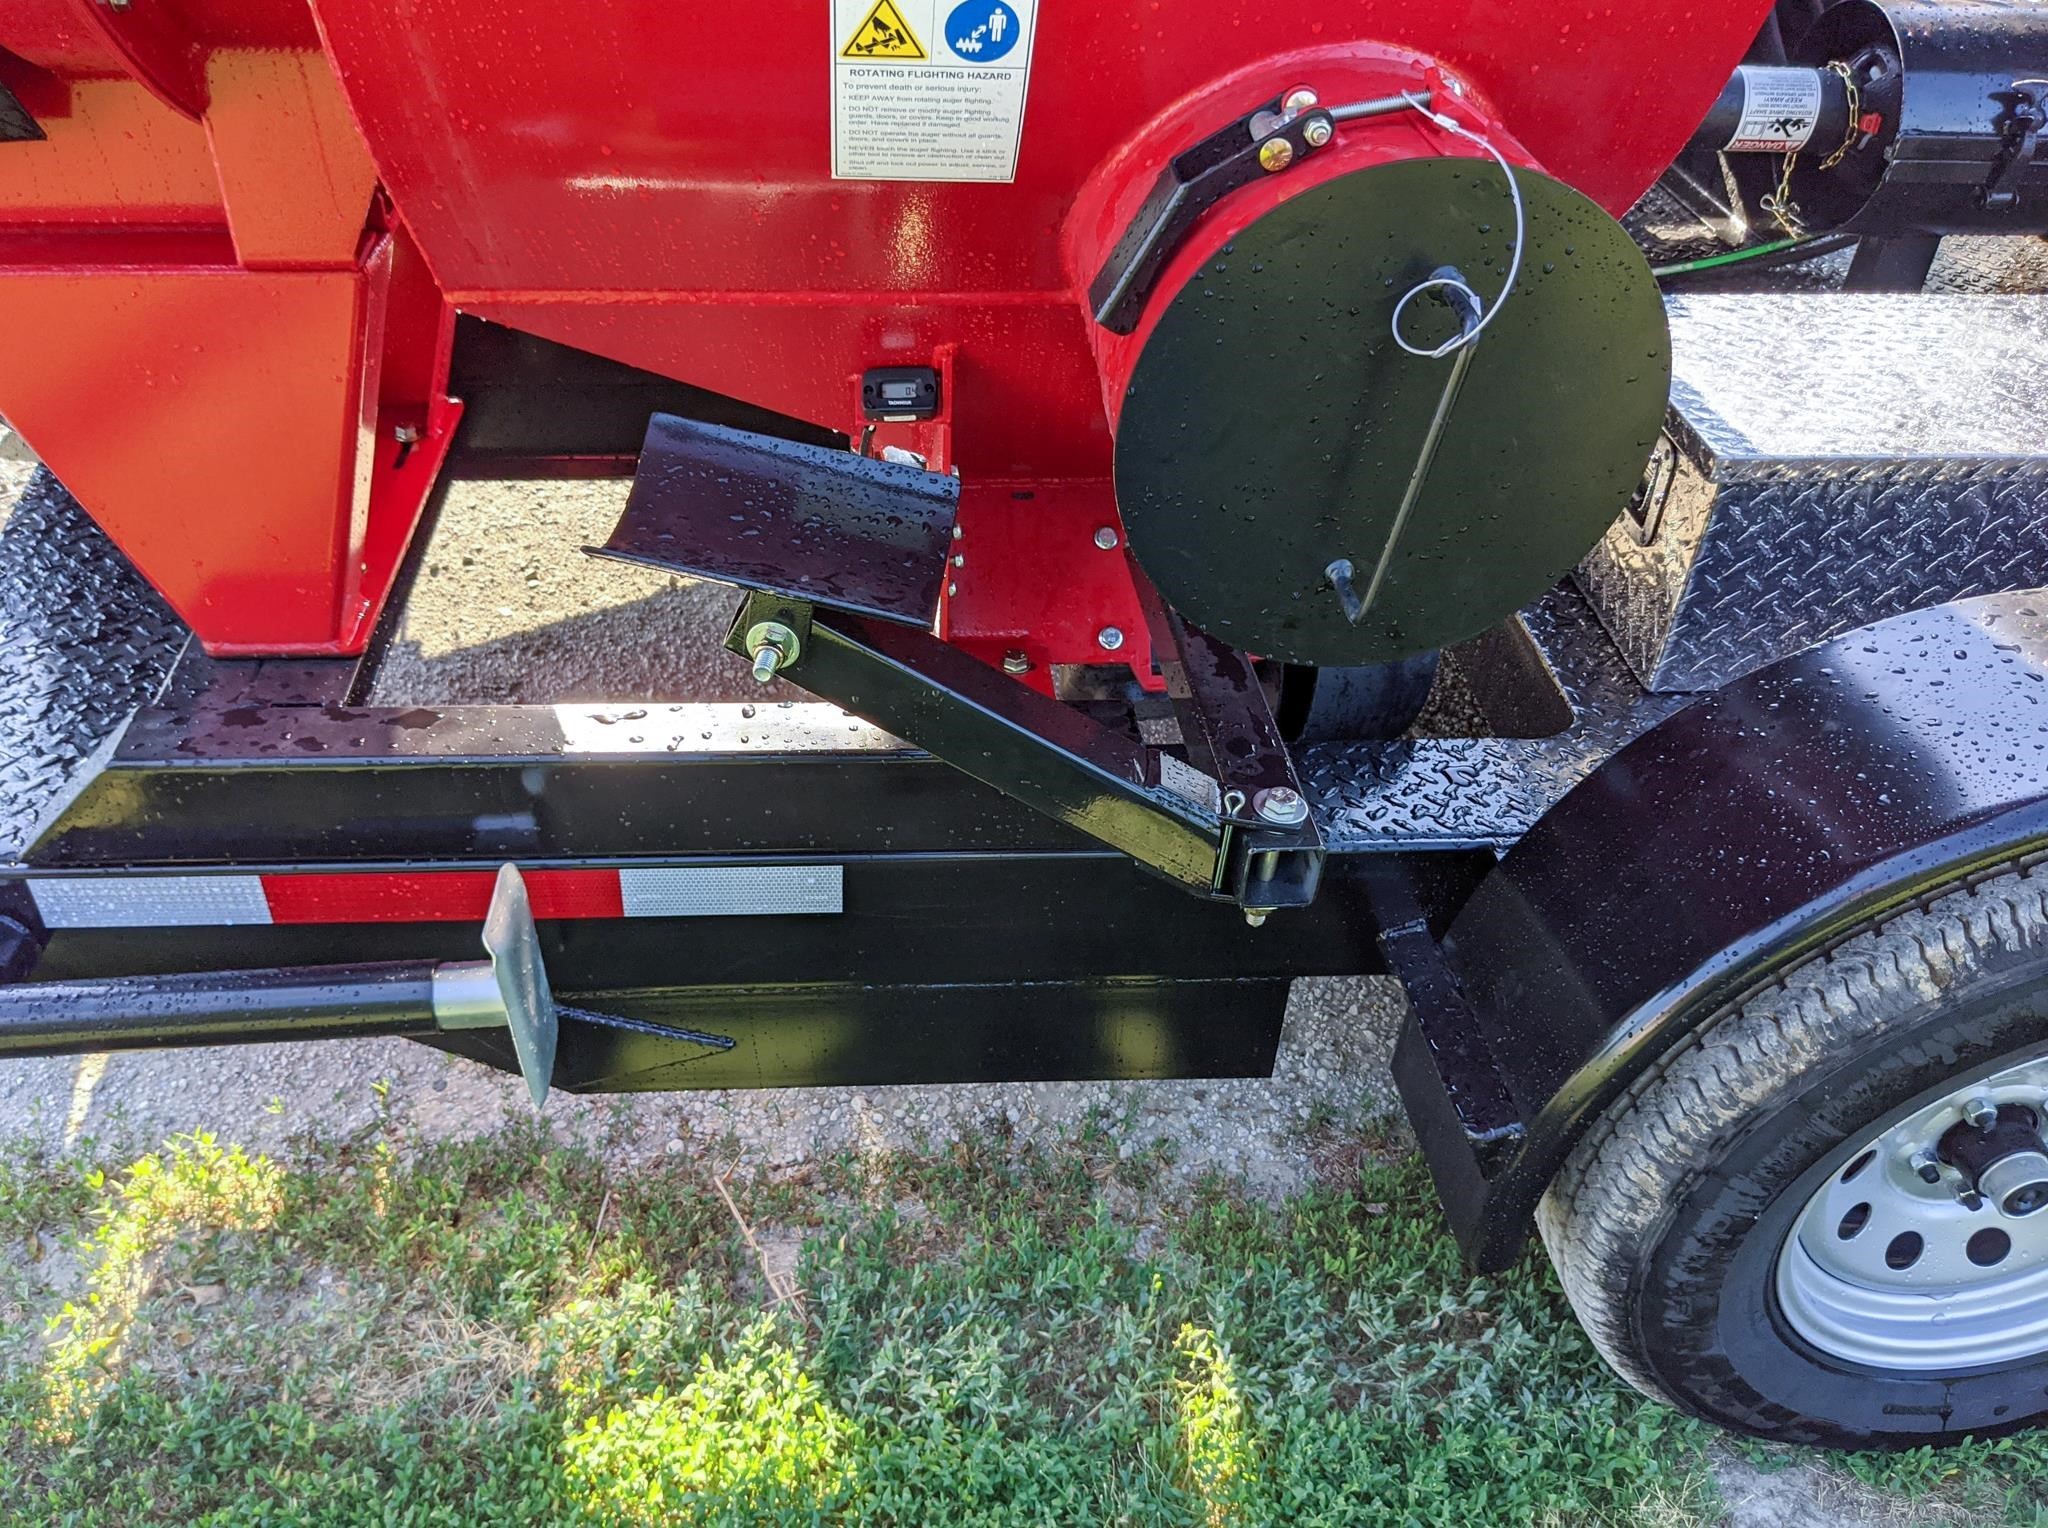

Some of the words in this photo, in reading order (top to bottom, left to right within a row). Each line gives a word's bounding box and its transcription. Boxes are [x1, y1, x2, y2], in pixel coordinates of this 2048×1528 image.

[850, 69, 904, 78] ROTATING
[908, 70, 964, 79] FLIGHTING
[967, 72, 1012, 80] HAZARD
[1734, 141, 1785, 149] DANGER
